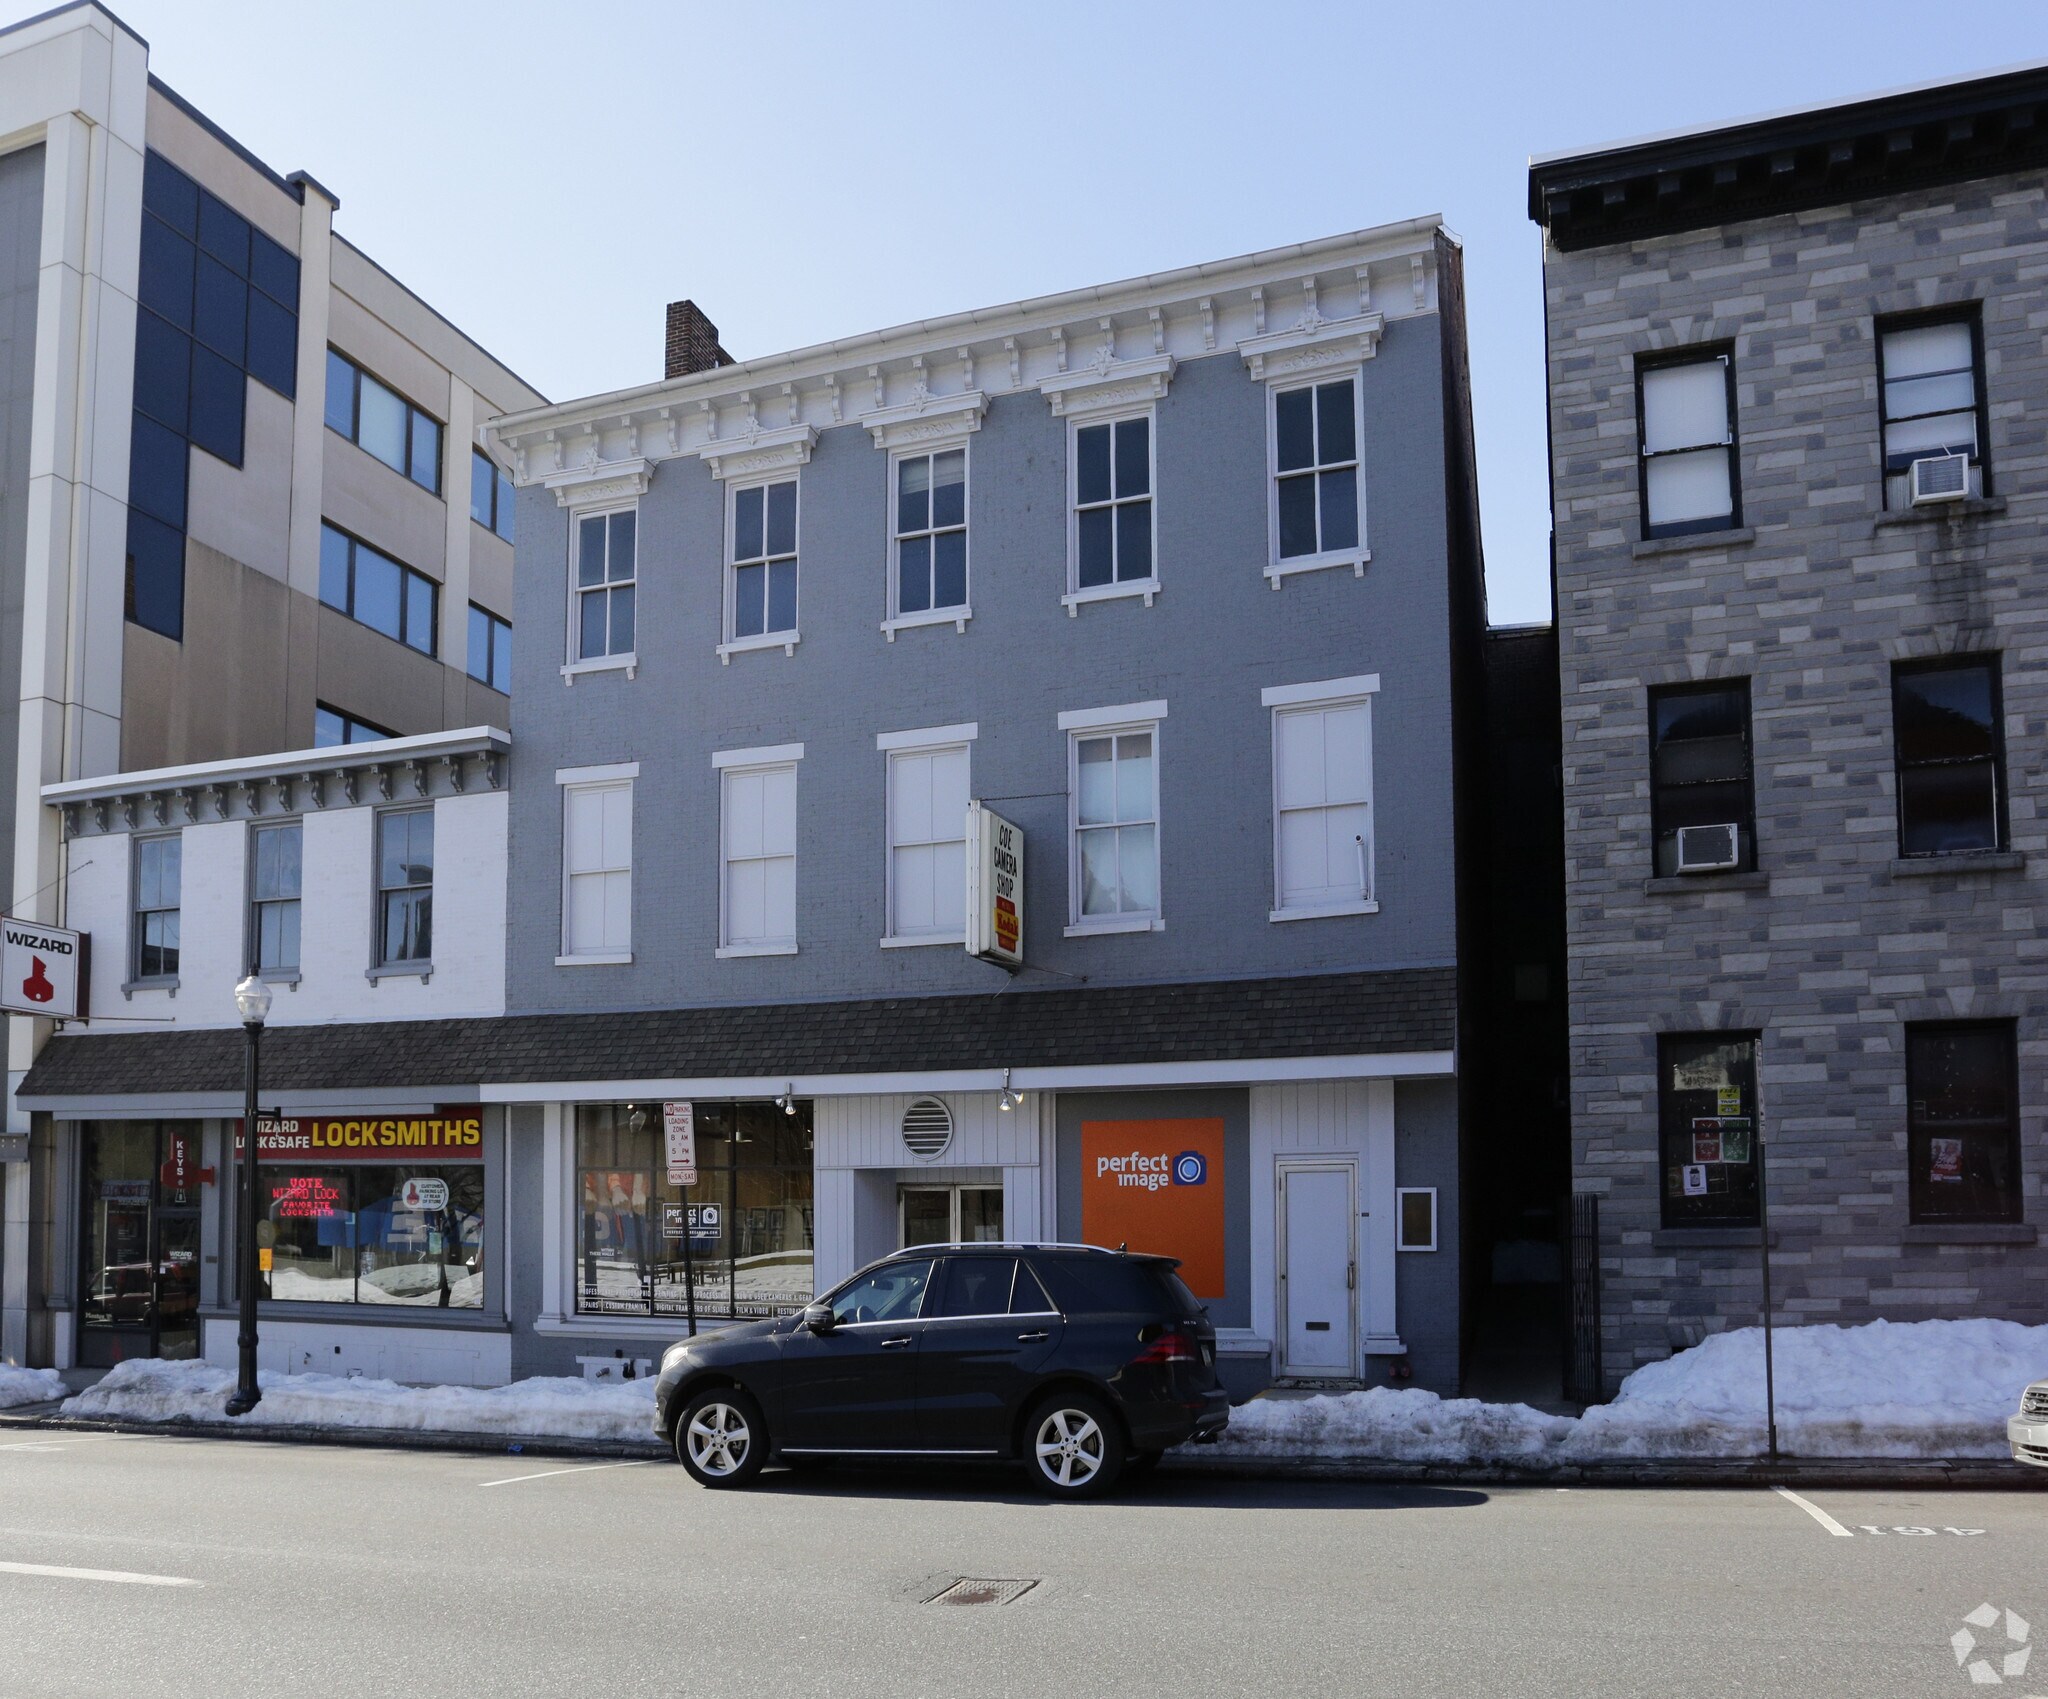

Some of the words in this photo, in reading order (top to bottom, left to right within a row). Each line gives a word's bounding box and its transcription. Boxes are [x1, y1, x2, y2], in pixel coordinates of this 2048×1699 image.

[999, 824, 1012, 850] COE
[993, 846, 1017, 877] CAMERA
[996, 873, 1013, 898] SHOP
[997, 913, 1018, 937] Kodak
[6, 930, 73, 955] WIZARD
[666, 1104, 673, 1115] NO
[312, 1119, 480, 1147] LOCKSMITHS
[176, 1140, 184, 1176] KEYS
[1097, 1151, 1168, 1178] perfect
[272, 1187, 309, 1199] WIZARD
[314, 1188, 339, 1200] LOCK
[290, 1178, 323, 1188] VOTE
[1118, 1173, 1169, 1191] image
[283, 1201, 330, 1209] FAVORITE
[656, 1303, 674, 1311] DIGITAL
